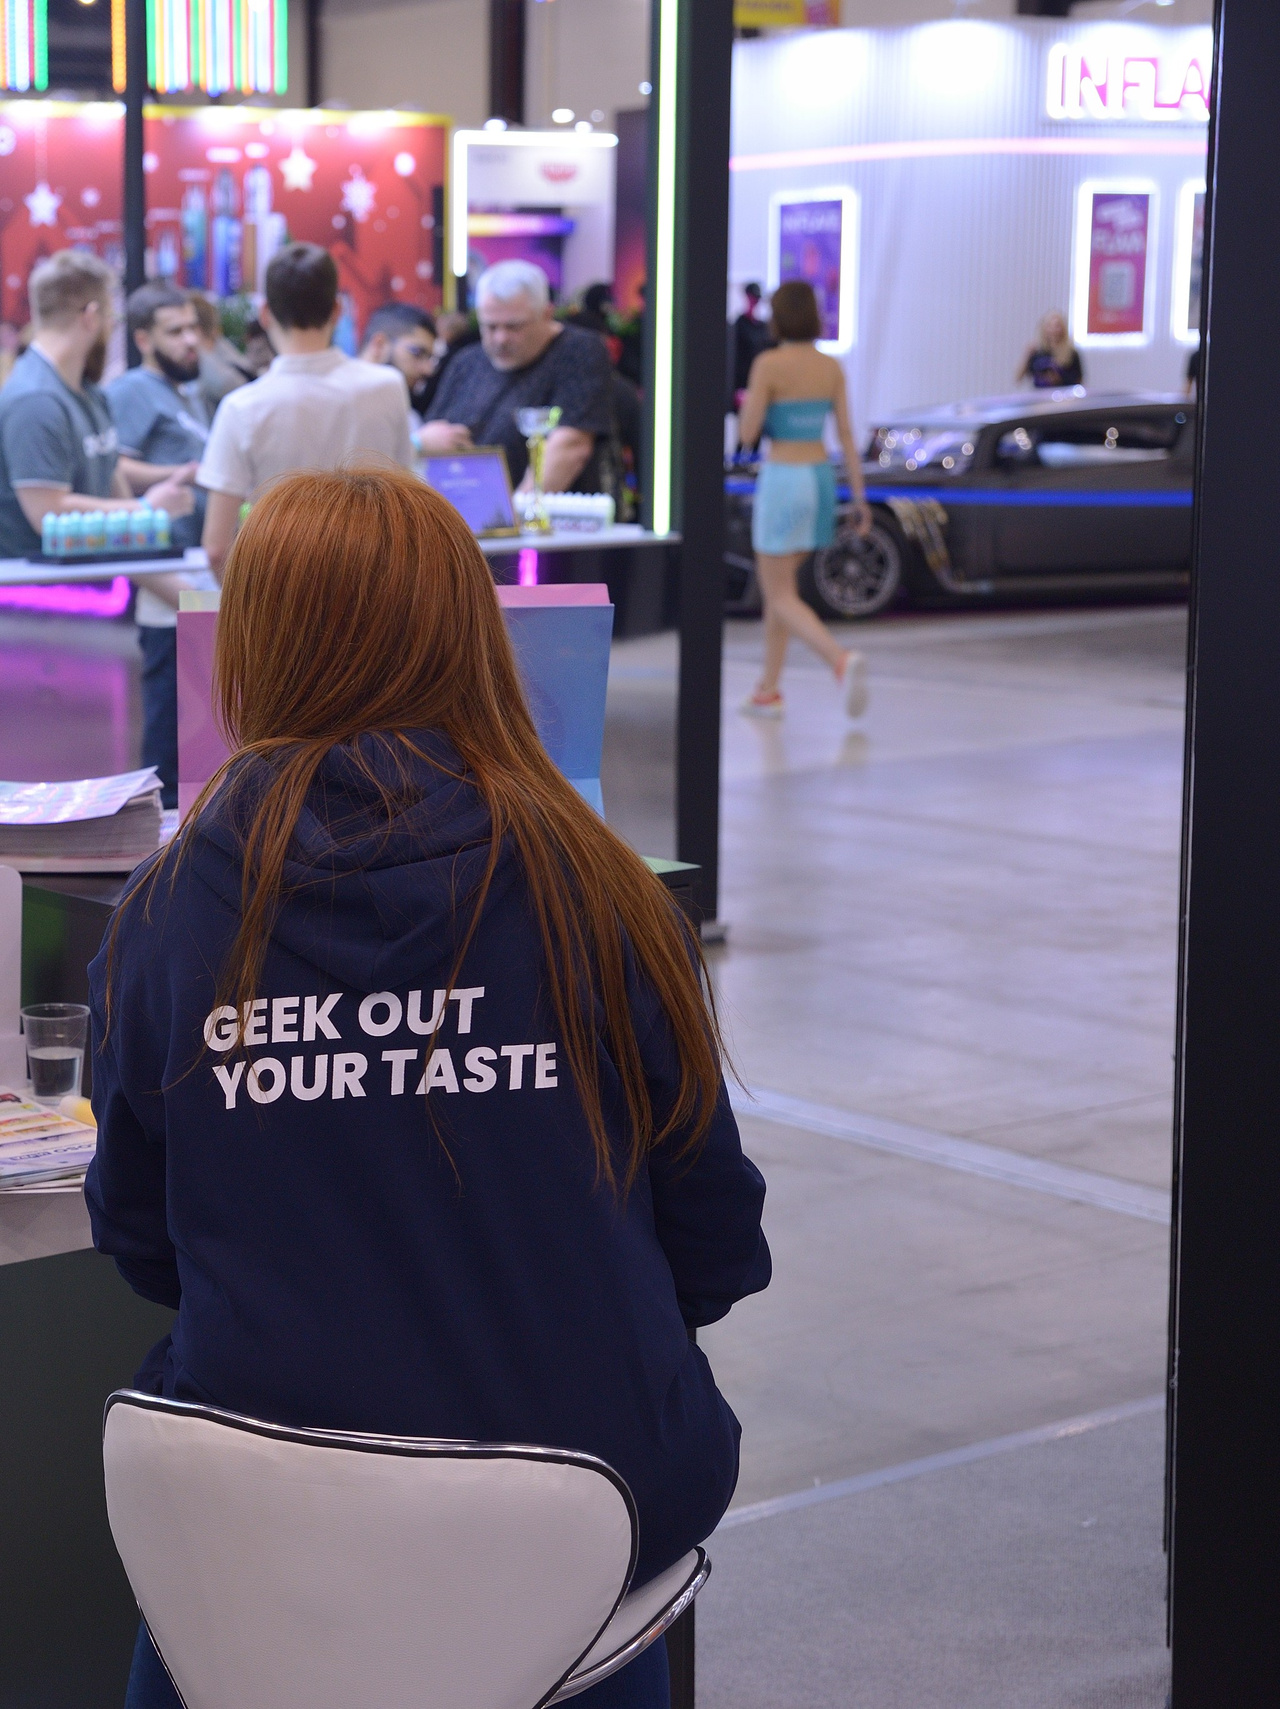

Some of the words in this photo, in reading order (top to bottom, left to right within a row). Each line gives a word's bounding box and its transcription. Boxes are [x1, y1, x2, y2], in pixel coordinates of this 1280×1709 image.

[203, 992, 344, 1052] GEEK
[358, 986, 485, 1037] OUT
[212, 1052, 369, 1111] YOUR
[381, 1042, 559, 1096] TASTE
